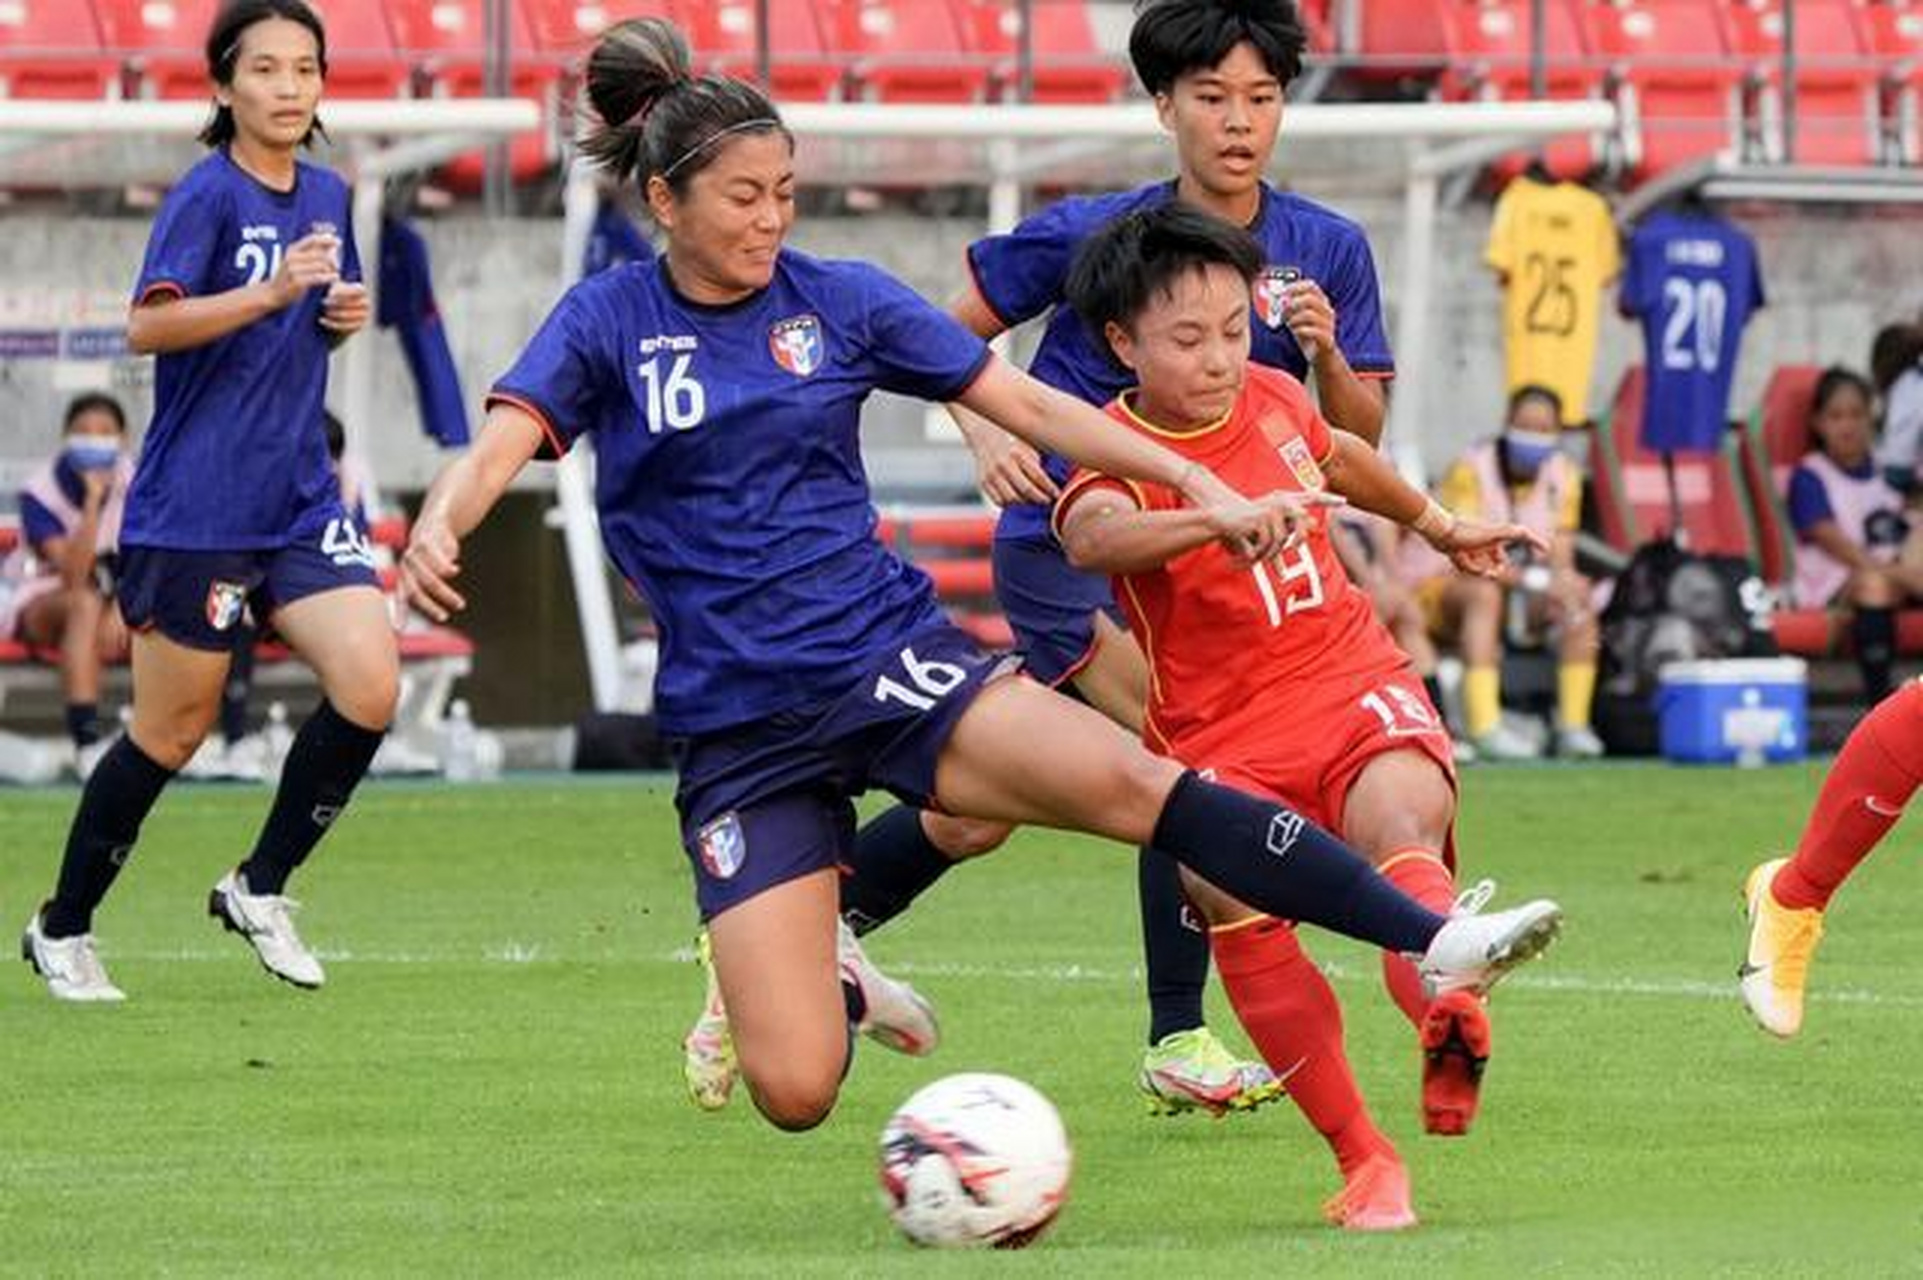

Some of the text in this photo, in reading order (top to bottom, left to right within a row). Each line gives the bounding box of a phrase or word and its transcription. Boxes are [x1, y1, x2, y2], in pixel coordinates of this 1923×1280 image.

[1526, 252, 1579, 337] 25
[1663, 275, 1727, 373] 20
[638, 353, 706, 434] 16
[1252, 530, 1325, 628] 19
[873, 647, 967, 712] 16
